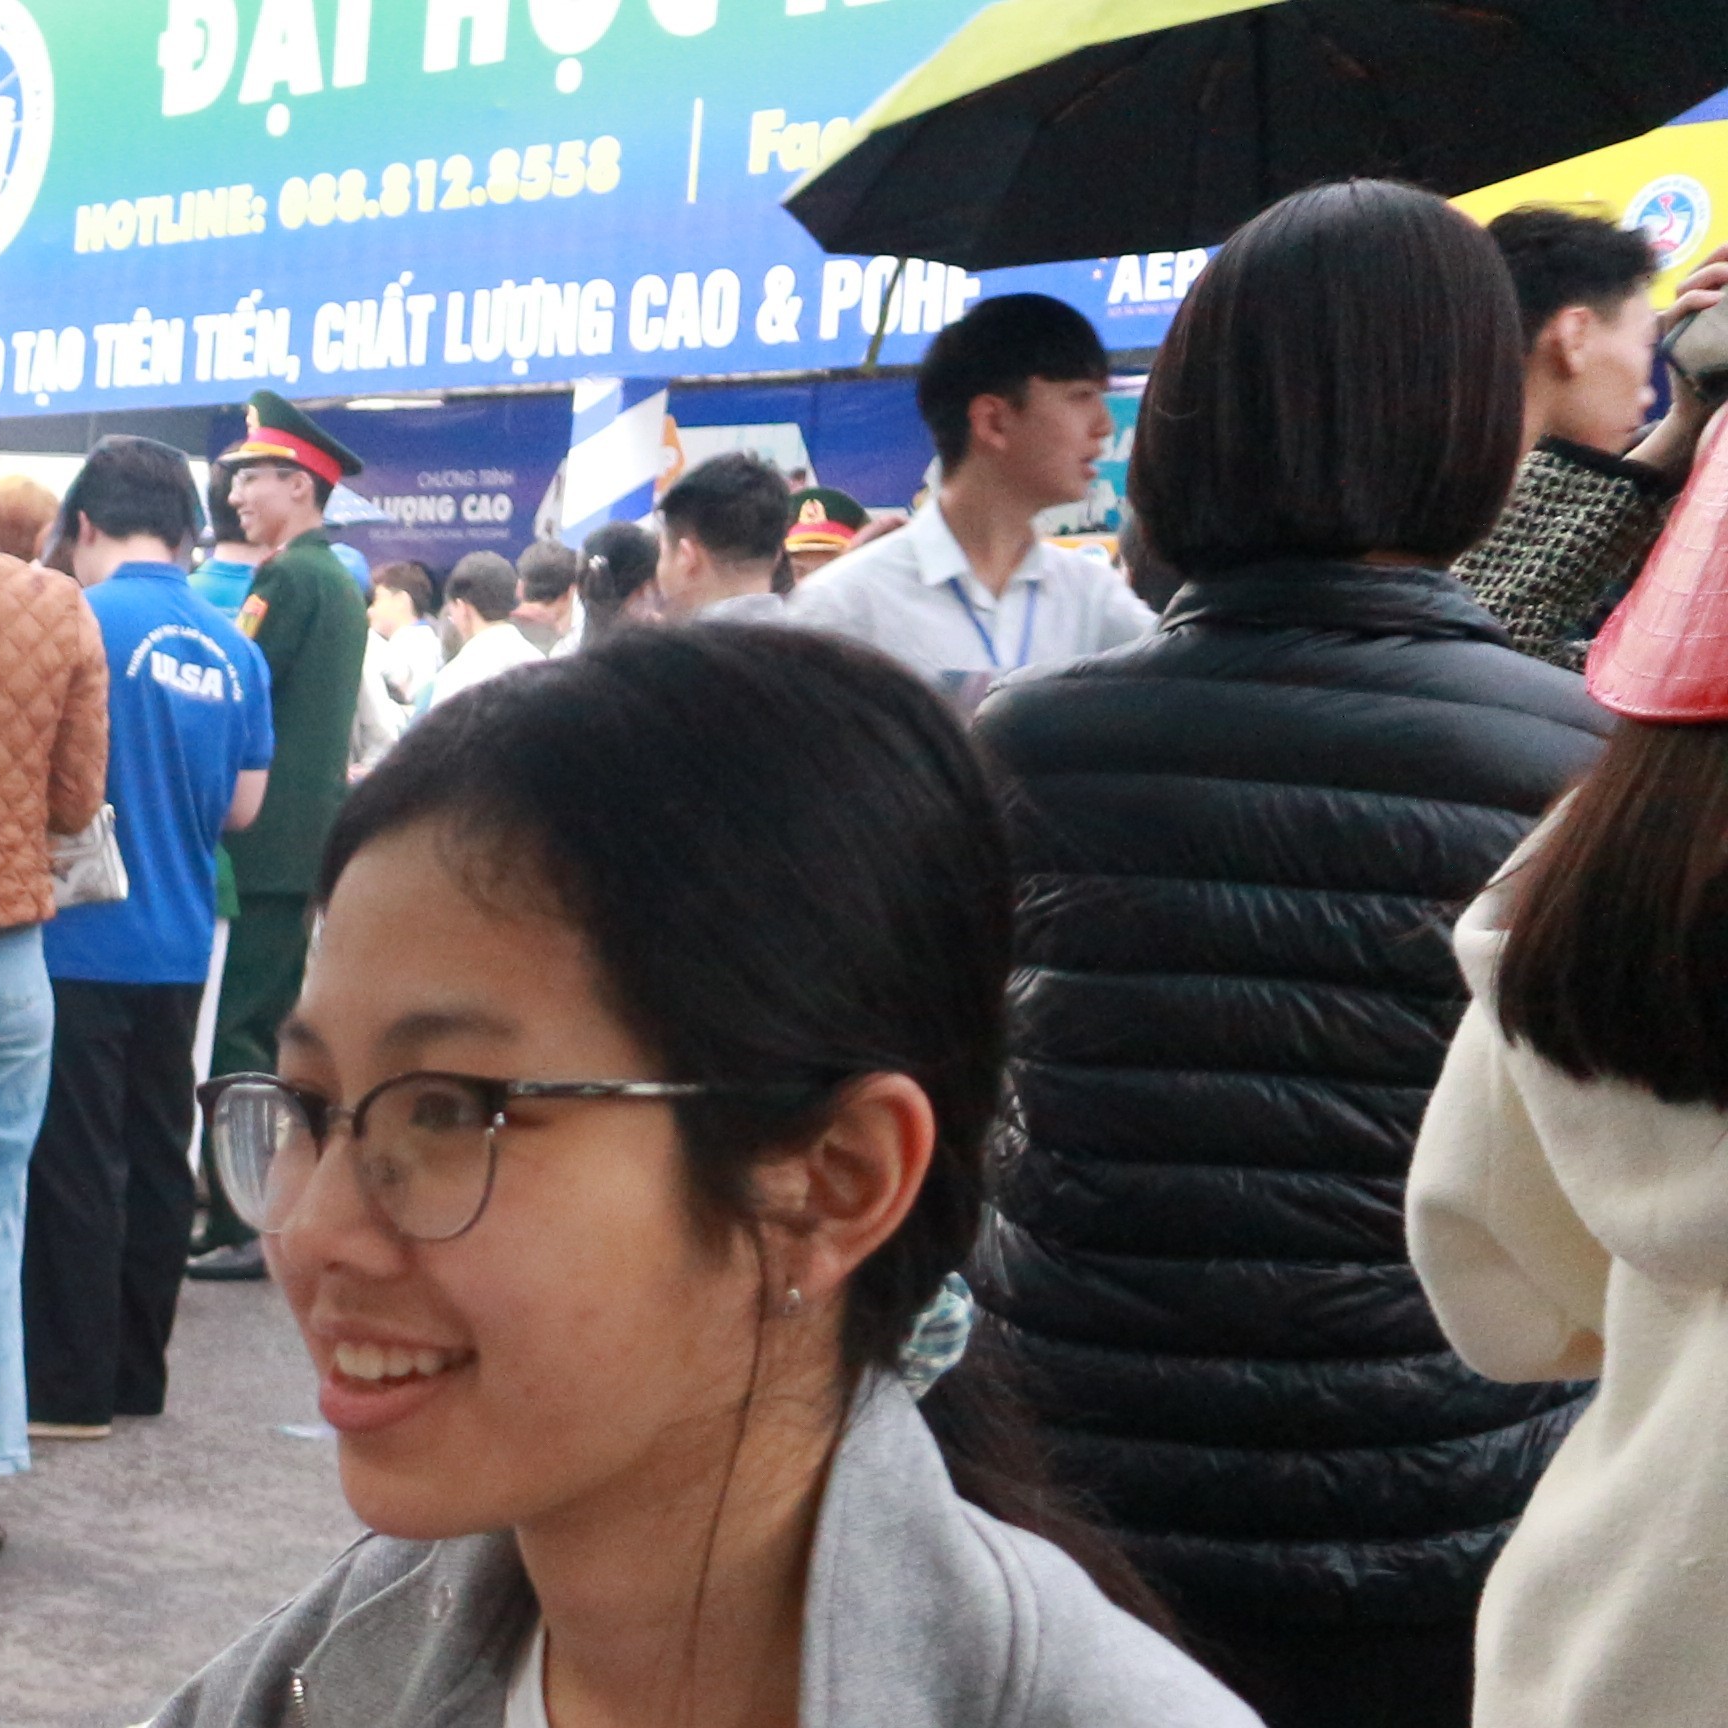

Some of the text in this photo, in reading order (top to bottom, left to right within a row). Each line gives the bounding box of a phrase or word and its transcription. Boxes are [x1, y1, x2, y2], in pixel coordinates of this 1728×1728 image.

[158, 0, 371, 138] ĐẠI
[74, 183, 266, 254] HOTLINE:
[12, 325, 87, 407] TẠO
[311, 270, 437, 374] CHẤT
[443, 273, 616, 377] LƯỢNG
[629, 270, 740, 350] CAO
[755, 263, 804, 342] &
[461, 492, 514, 523] CAO
[150, 650, 223, 700] ULSA
